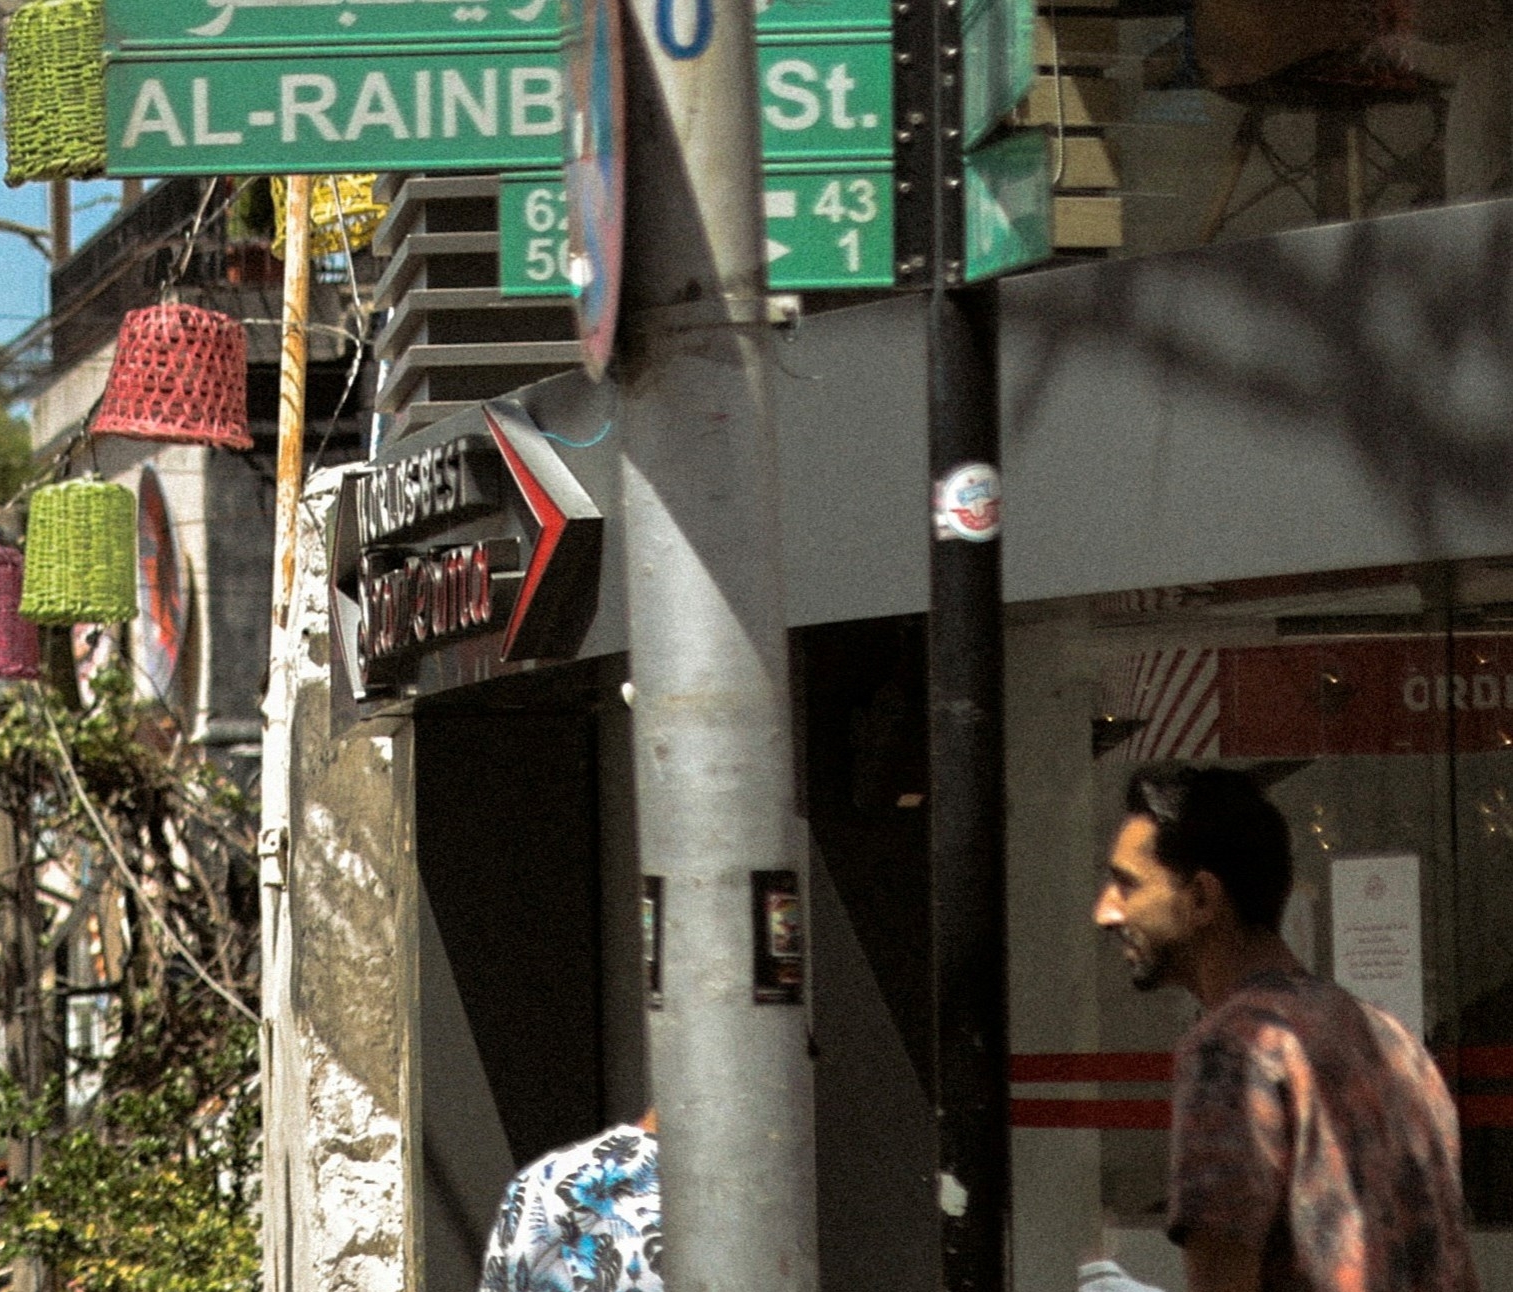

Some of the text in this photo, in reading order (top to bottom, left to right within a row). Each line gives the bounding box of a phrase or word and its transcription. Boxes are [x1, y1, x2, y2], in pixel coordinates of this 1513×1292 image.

[121, 59, 877, 149] AL-RAINB St.
[813, 179, 876, 223] 43
[838, 229, 860, 273] 1
